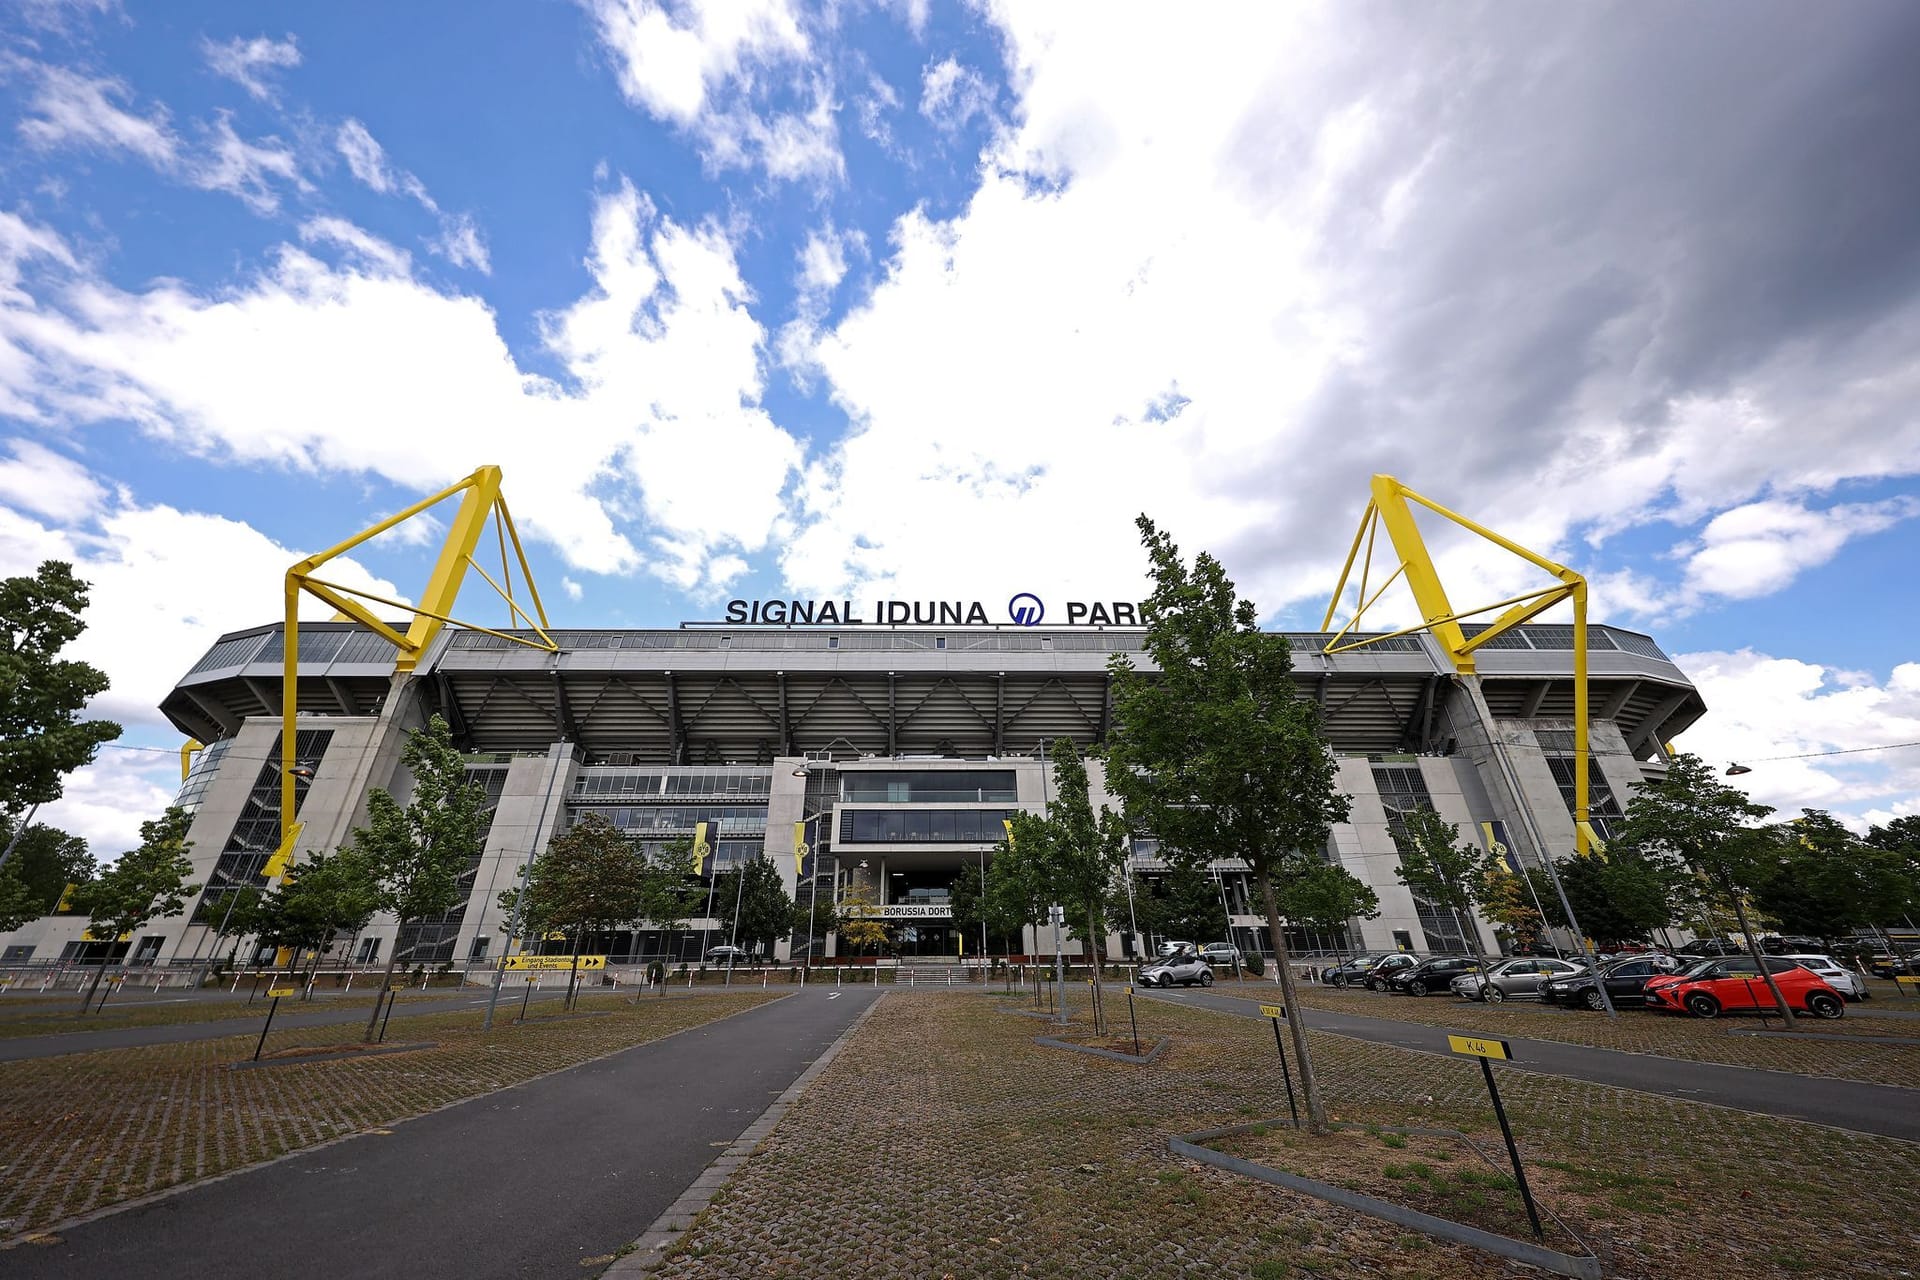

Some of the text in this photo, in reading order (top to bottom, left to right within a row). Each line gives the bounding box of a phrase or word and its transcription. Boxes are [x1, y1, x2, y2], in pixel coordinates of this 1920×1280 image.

[725, 600, 863, 624] SIGNAL
[876, 601, 990, 625] IDUNA
[884, 907, 926, 916] BORUSSIA
[1466, 1041, 1486, 1053] K 46
